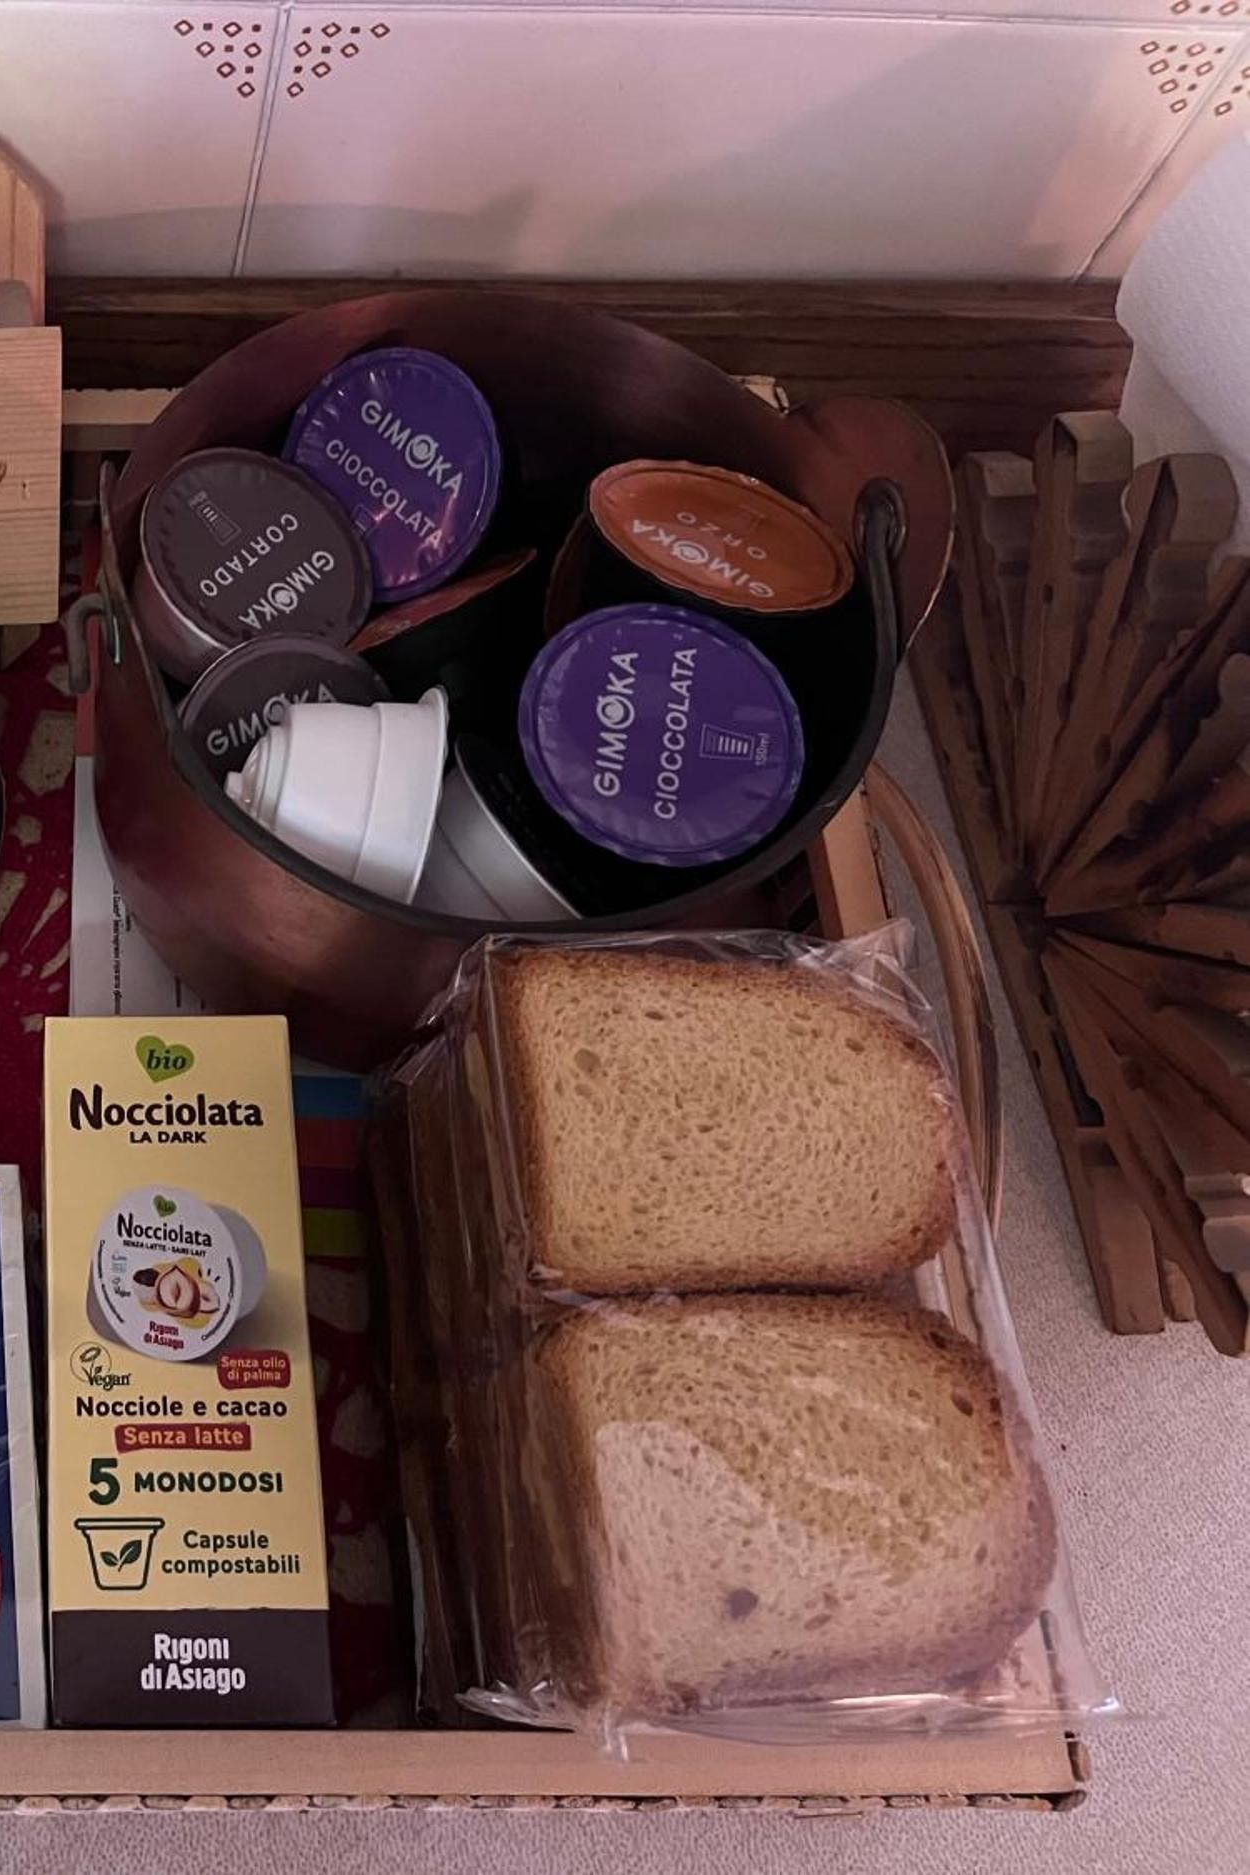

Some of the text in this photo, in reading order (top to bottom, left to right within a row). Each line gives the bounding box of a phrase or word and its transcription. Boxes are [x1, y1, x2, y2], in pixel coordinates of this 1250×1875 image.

[360, 399, 465, 500] GIMOKA
[325, 438, 444, 550] CIOCCOLATA
[676, 511, 767, 560] ORZO
[200, 513, 299, 598] CORTADO
[632, 519, 775, 598] GIMOKA
[238, 549, 336, 631] GIMOKA
[592, 649, 640, 798] GIMOKA
[653, 646, 698, 820] CIOCCOLATA
[147, 1048, 187, 1070] bio
[69, 1083, 264, 1131] Nocciolata
[129, 1130, 207, 1144] LA DARK
[116, 1212, 213, 1248] Nocciolata
[82, 1365, 132, 1391] Vegan
[221, 1355, 259, 1369] Senza
[227, 1369, 282, 1383] di palma
[76, 1395, 288, 1418] Nocciole e cacao
[123, 1426, 244, 1446] Senza latte
[88, 1457, 283, 1506] 5 MONODOSI
[183, 1529, 269, 1554] Capsule
[161, 1554, 301, 1579] compostabili
[154, 1632, 230, 1665] Rigoni
